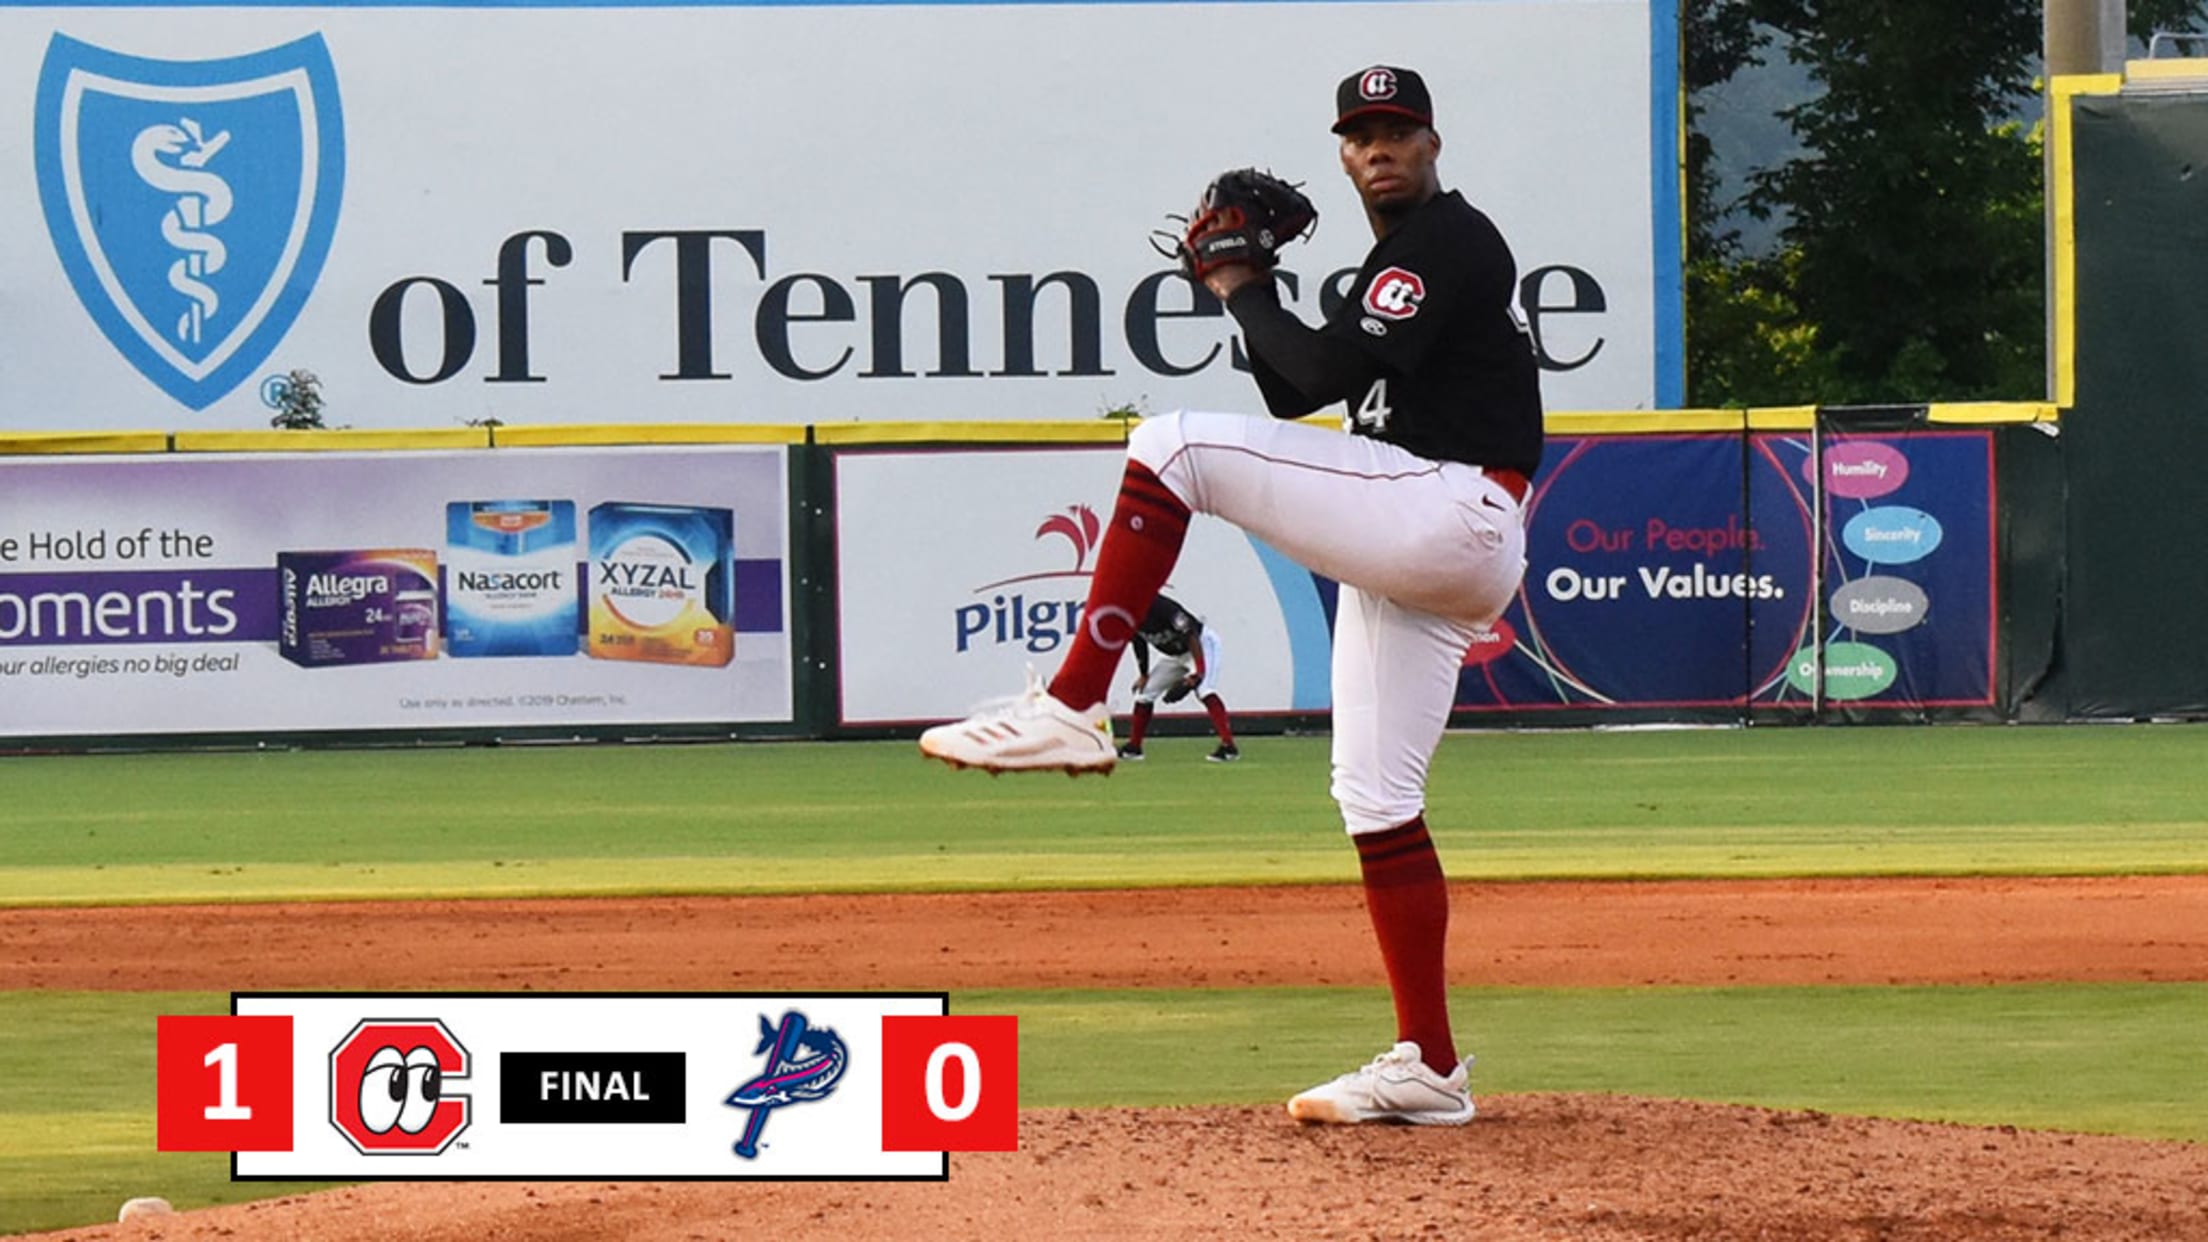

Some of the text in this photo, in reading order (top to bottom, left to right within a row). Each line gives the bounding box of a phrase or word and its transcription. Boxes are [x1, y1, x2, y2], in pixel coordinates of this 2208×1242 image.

[369, 229, 1607, 385] of Tennee
[1831, 460, 1887, 479] Humility
[30, 529, 106, 560] Hold
[116, 528, 152, 559] of
[159, 529, 214, 558] the
[1567, 513, 1766, 558] Our People.
[1864, 526, 1921, 543] Sincerity
[306, 574, 388, 600] Allegra
[458, 571, 561, 591] Nasacort
[600, 562, 697, 590] XYZAL
[1546, 562, 1784, 601] Our Values.
[611, 587, 656, 598] ALLERGY
[1850, 598, 1913, 616] Discipline
[955, 594, 1087, 653] Pilgr
[30, 655, 119, 679] allergies
[123, 658, 151, 674] no
[155, 653, 188, 677] big
[192, 652, 240, 671] deal
